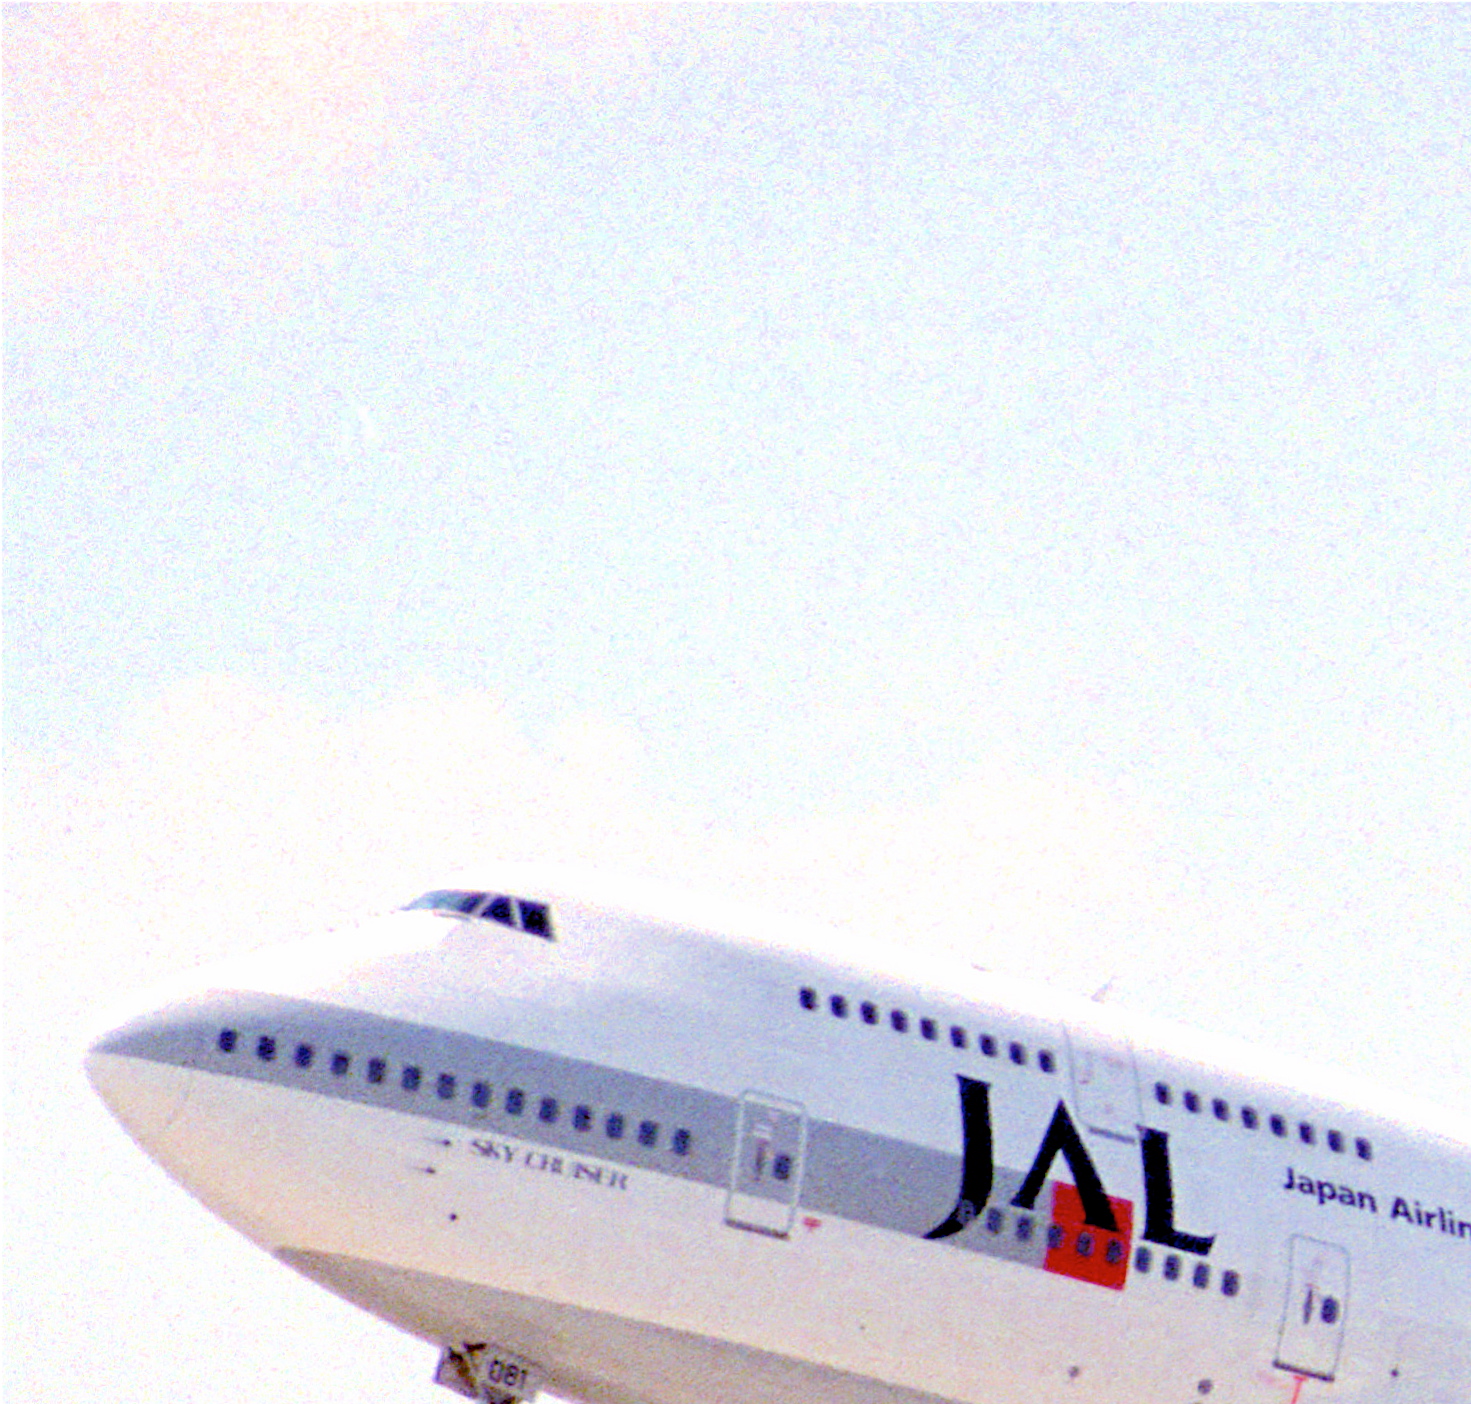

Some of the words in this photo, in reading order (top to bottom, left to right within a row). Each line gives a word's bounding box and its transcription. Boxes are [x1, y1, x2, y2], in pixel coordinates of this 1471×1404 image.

[923, 1074, 1217, 1257] JAL
[1283, 1166, 1378, 1213] Japan
[488, 1358, 528, 1389] 081
